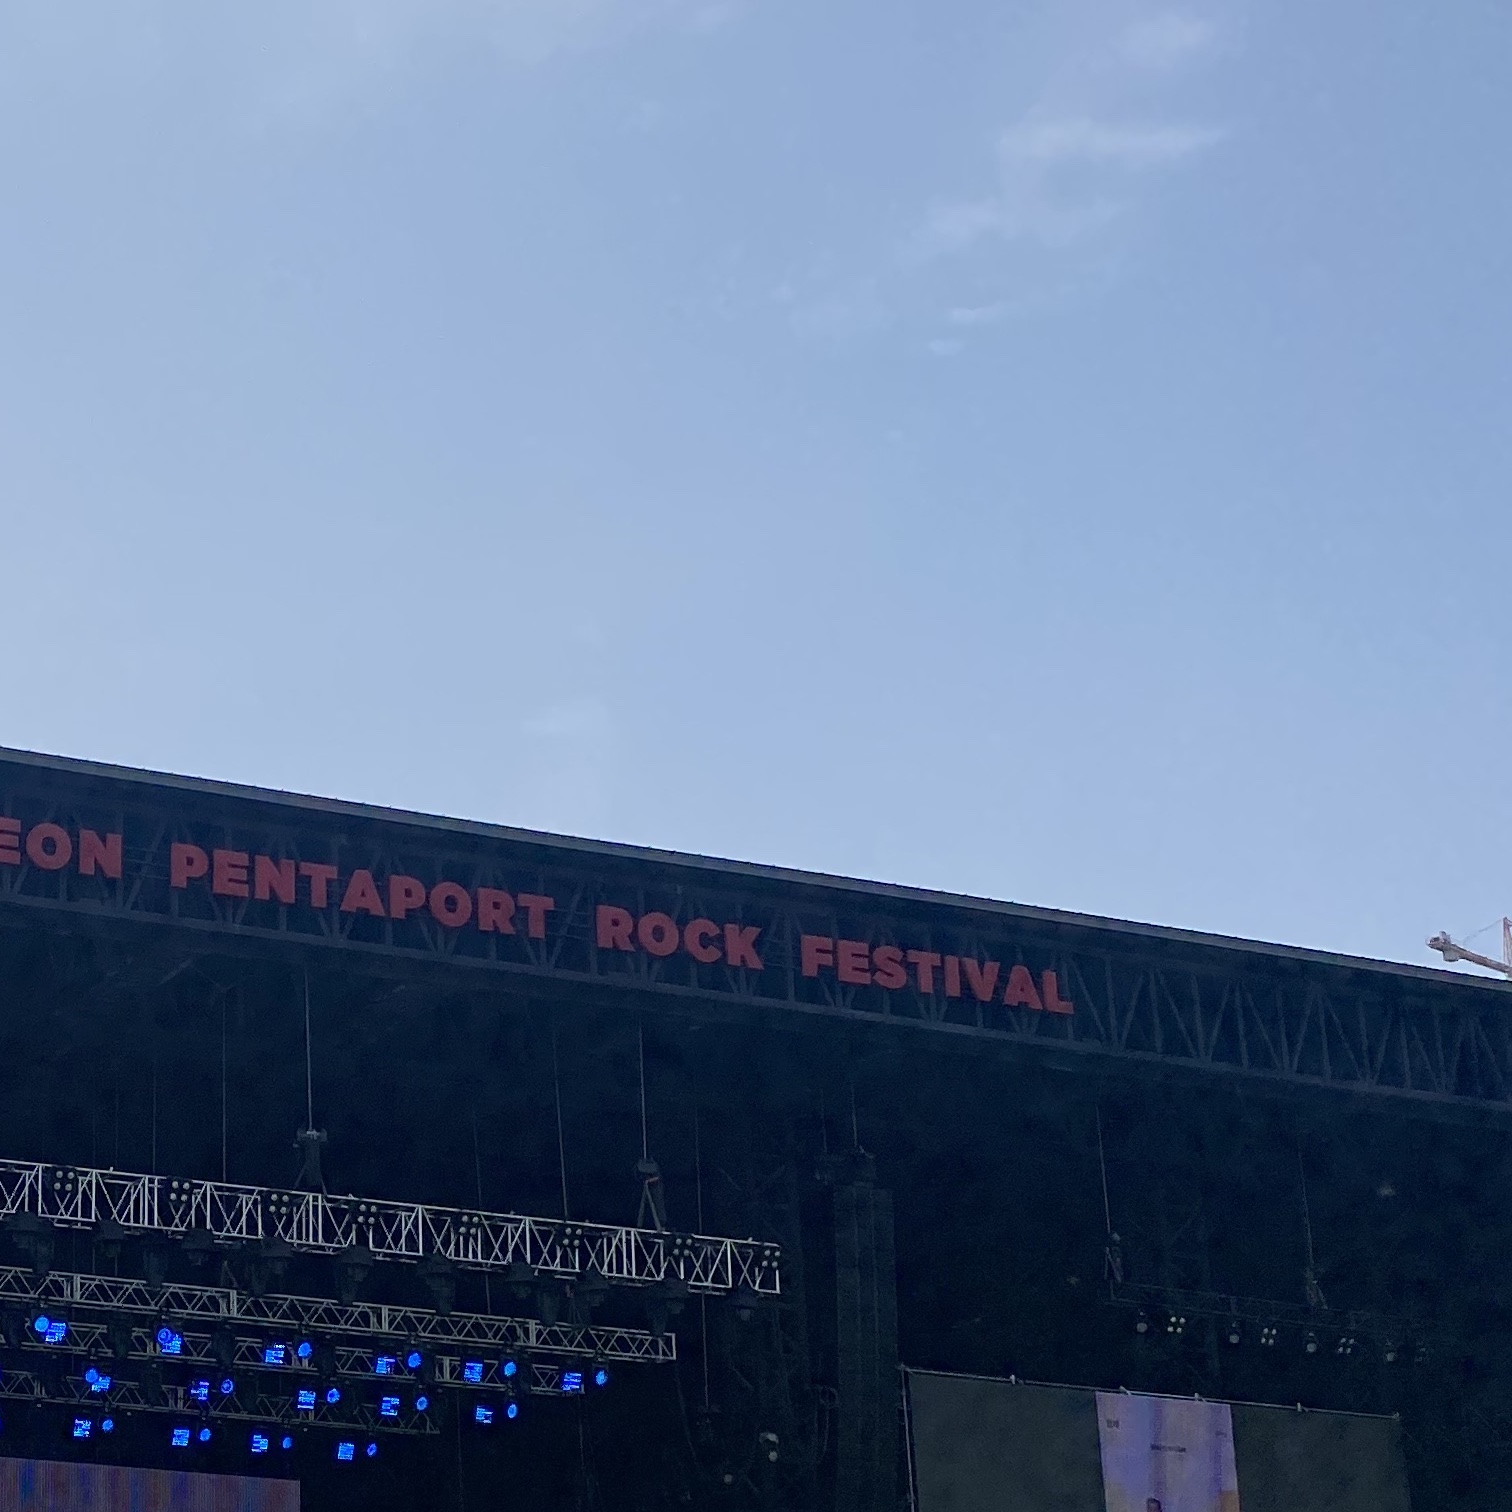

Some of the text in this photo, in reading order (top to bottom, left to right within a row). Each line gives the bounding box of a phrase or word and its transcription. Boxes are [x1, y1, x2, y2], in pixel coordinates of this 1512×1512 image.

[169, 842, 555, 939] PENTAPORT
[595, 904, 765, 970] ROCK
[799, 934, 1075, 1015] FESTIVAL
